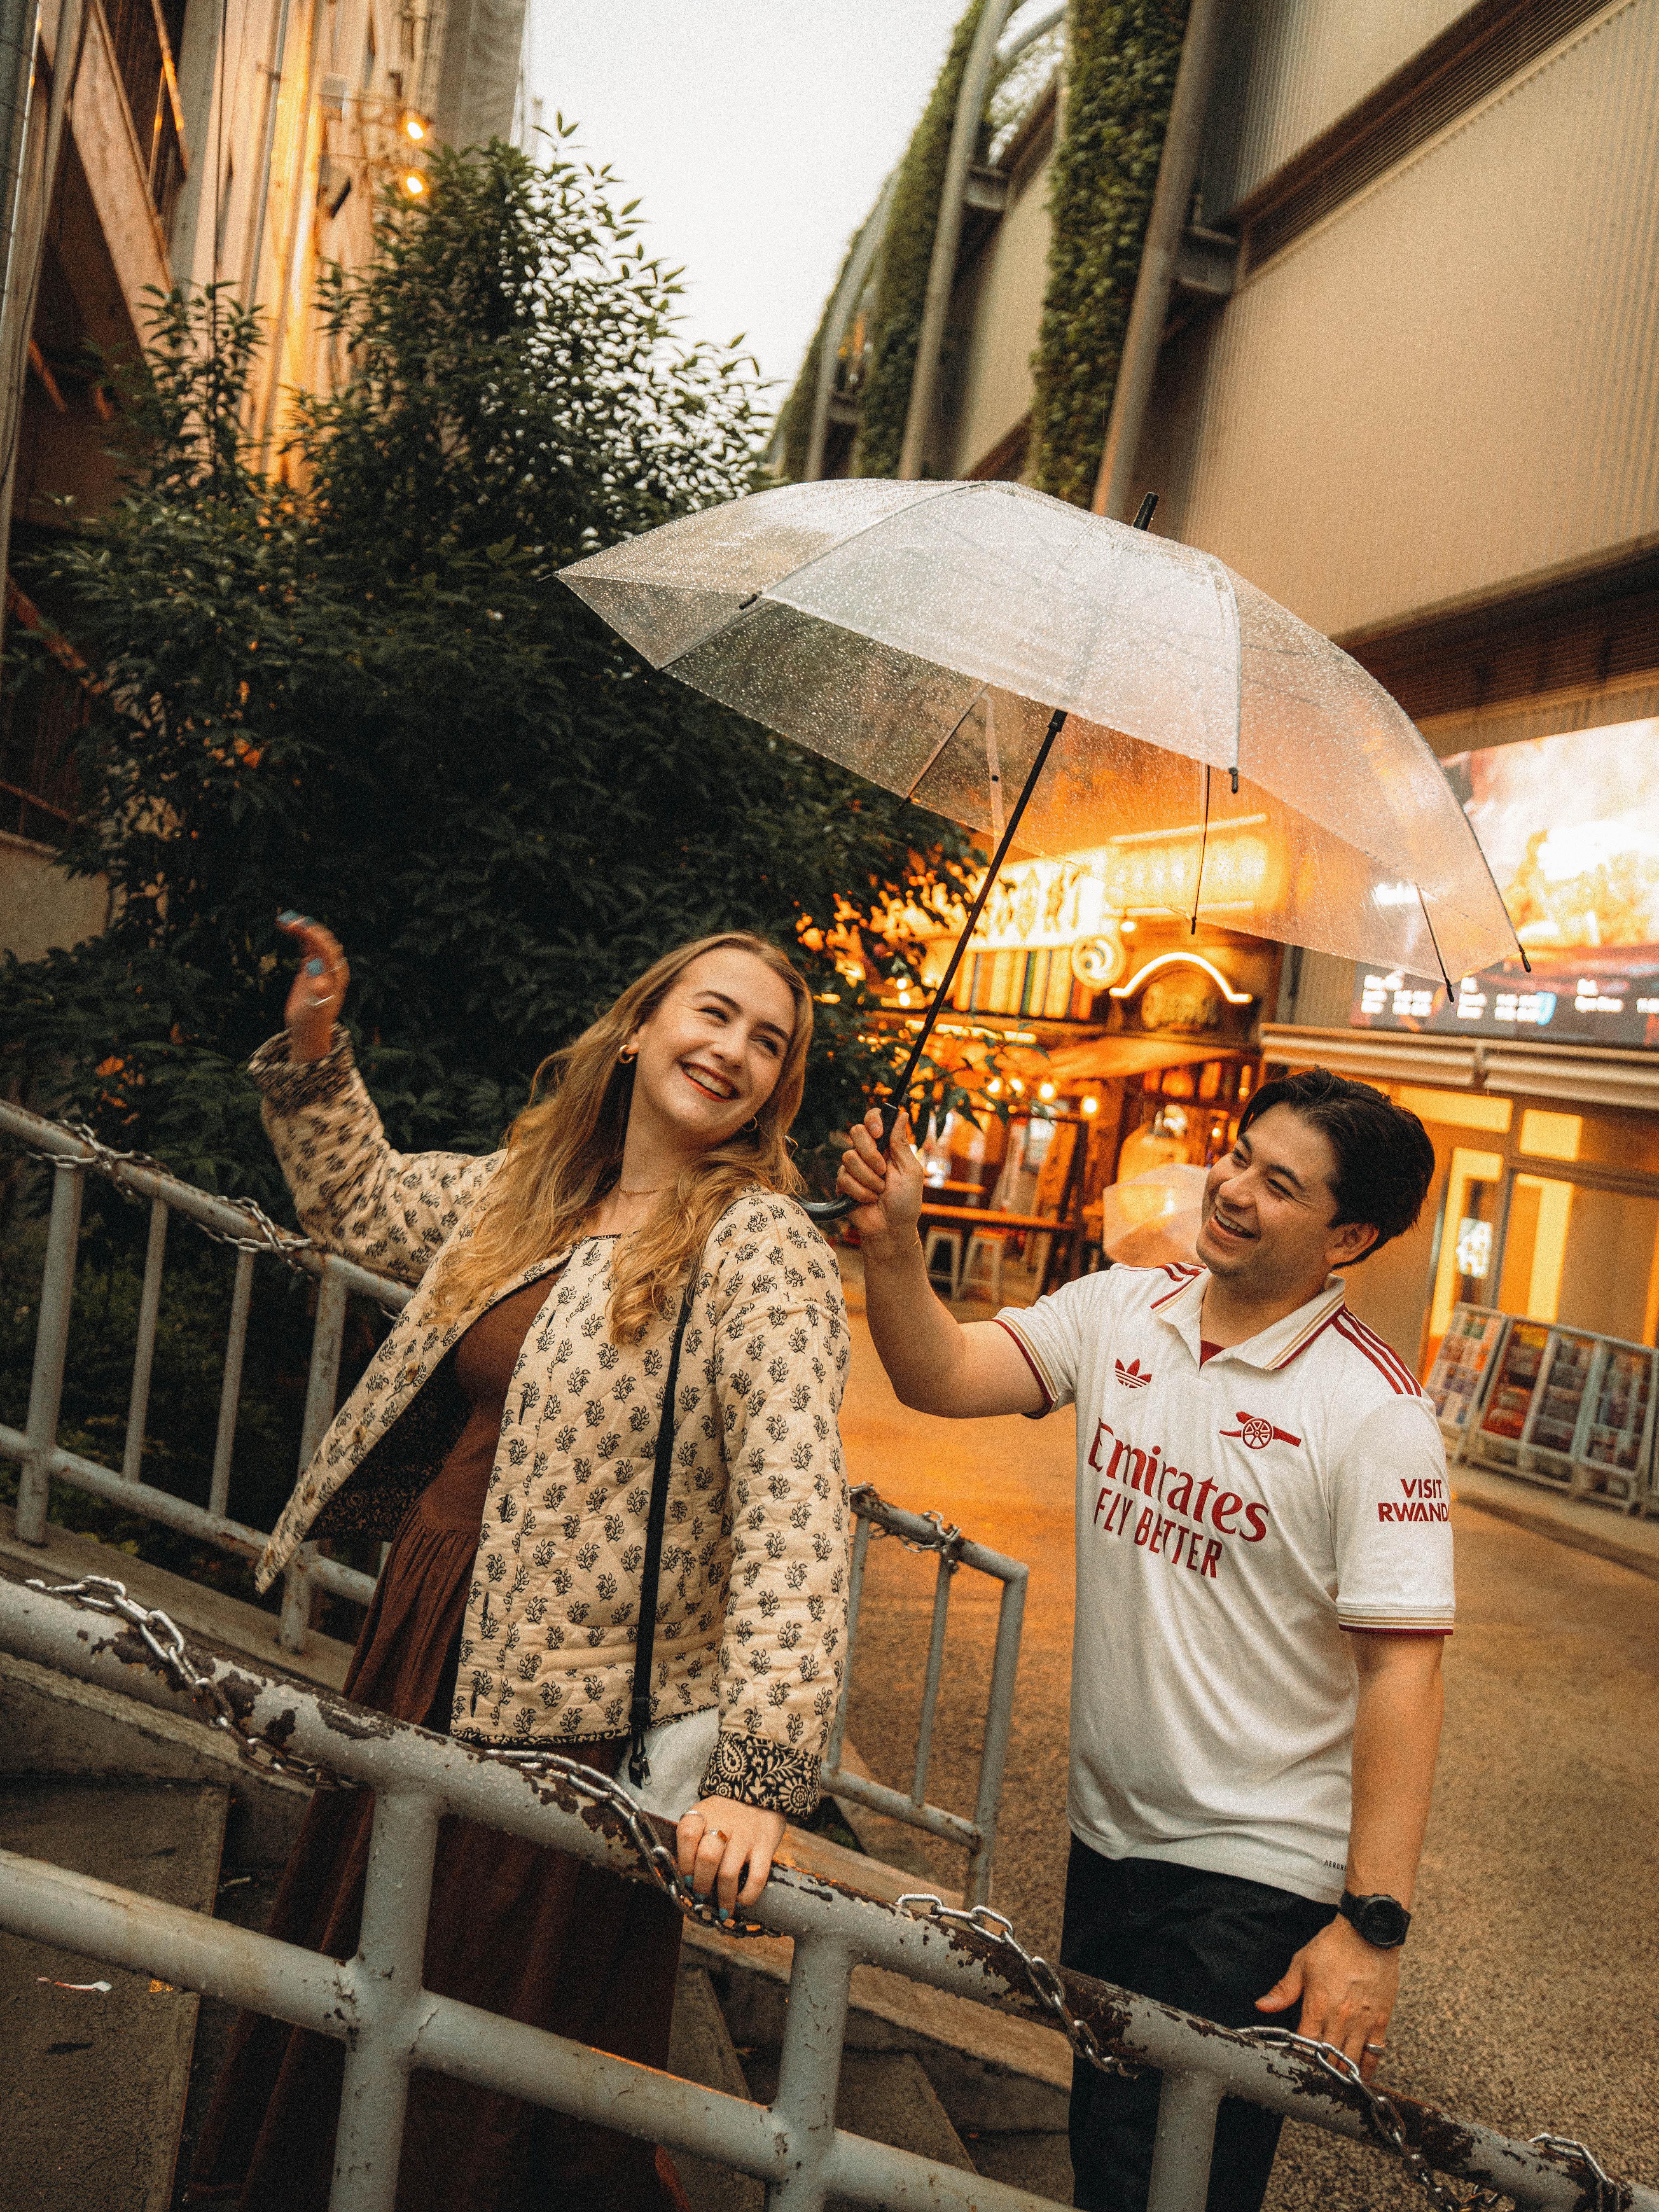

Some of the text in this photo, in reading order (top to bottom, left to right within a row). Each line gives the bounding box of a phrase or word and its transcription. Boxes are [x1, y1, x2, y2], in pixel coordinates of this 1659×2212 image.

[1088, 1417, 1269, 1542] Emirates
[1400, 1479, 1442, 1498] VISIT
[1094, 1487, 1223, 1578] FLY BETTER
[1378, 1502, 1449, 1522] RWAND
